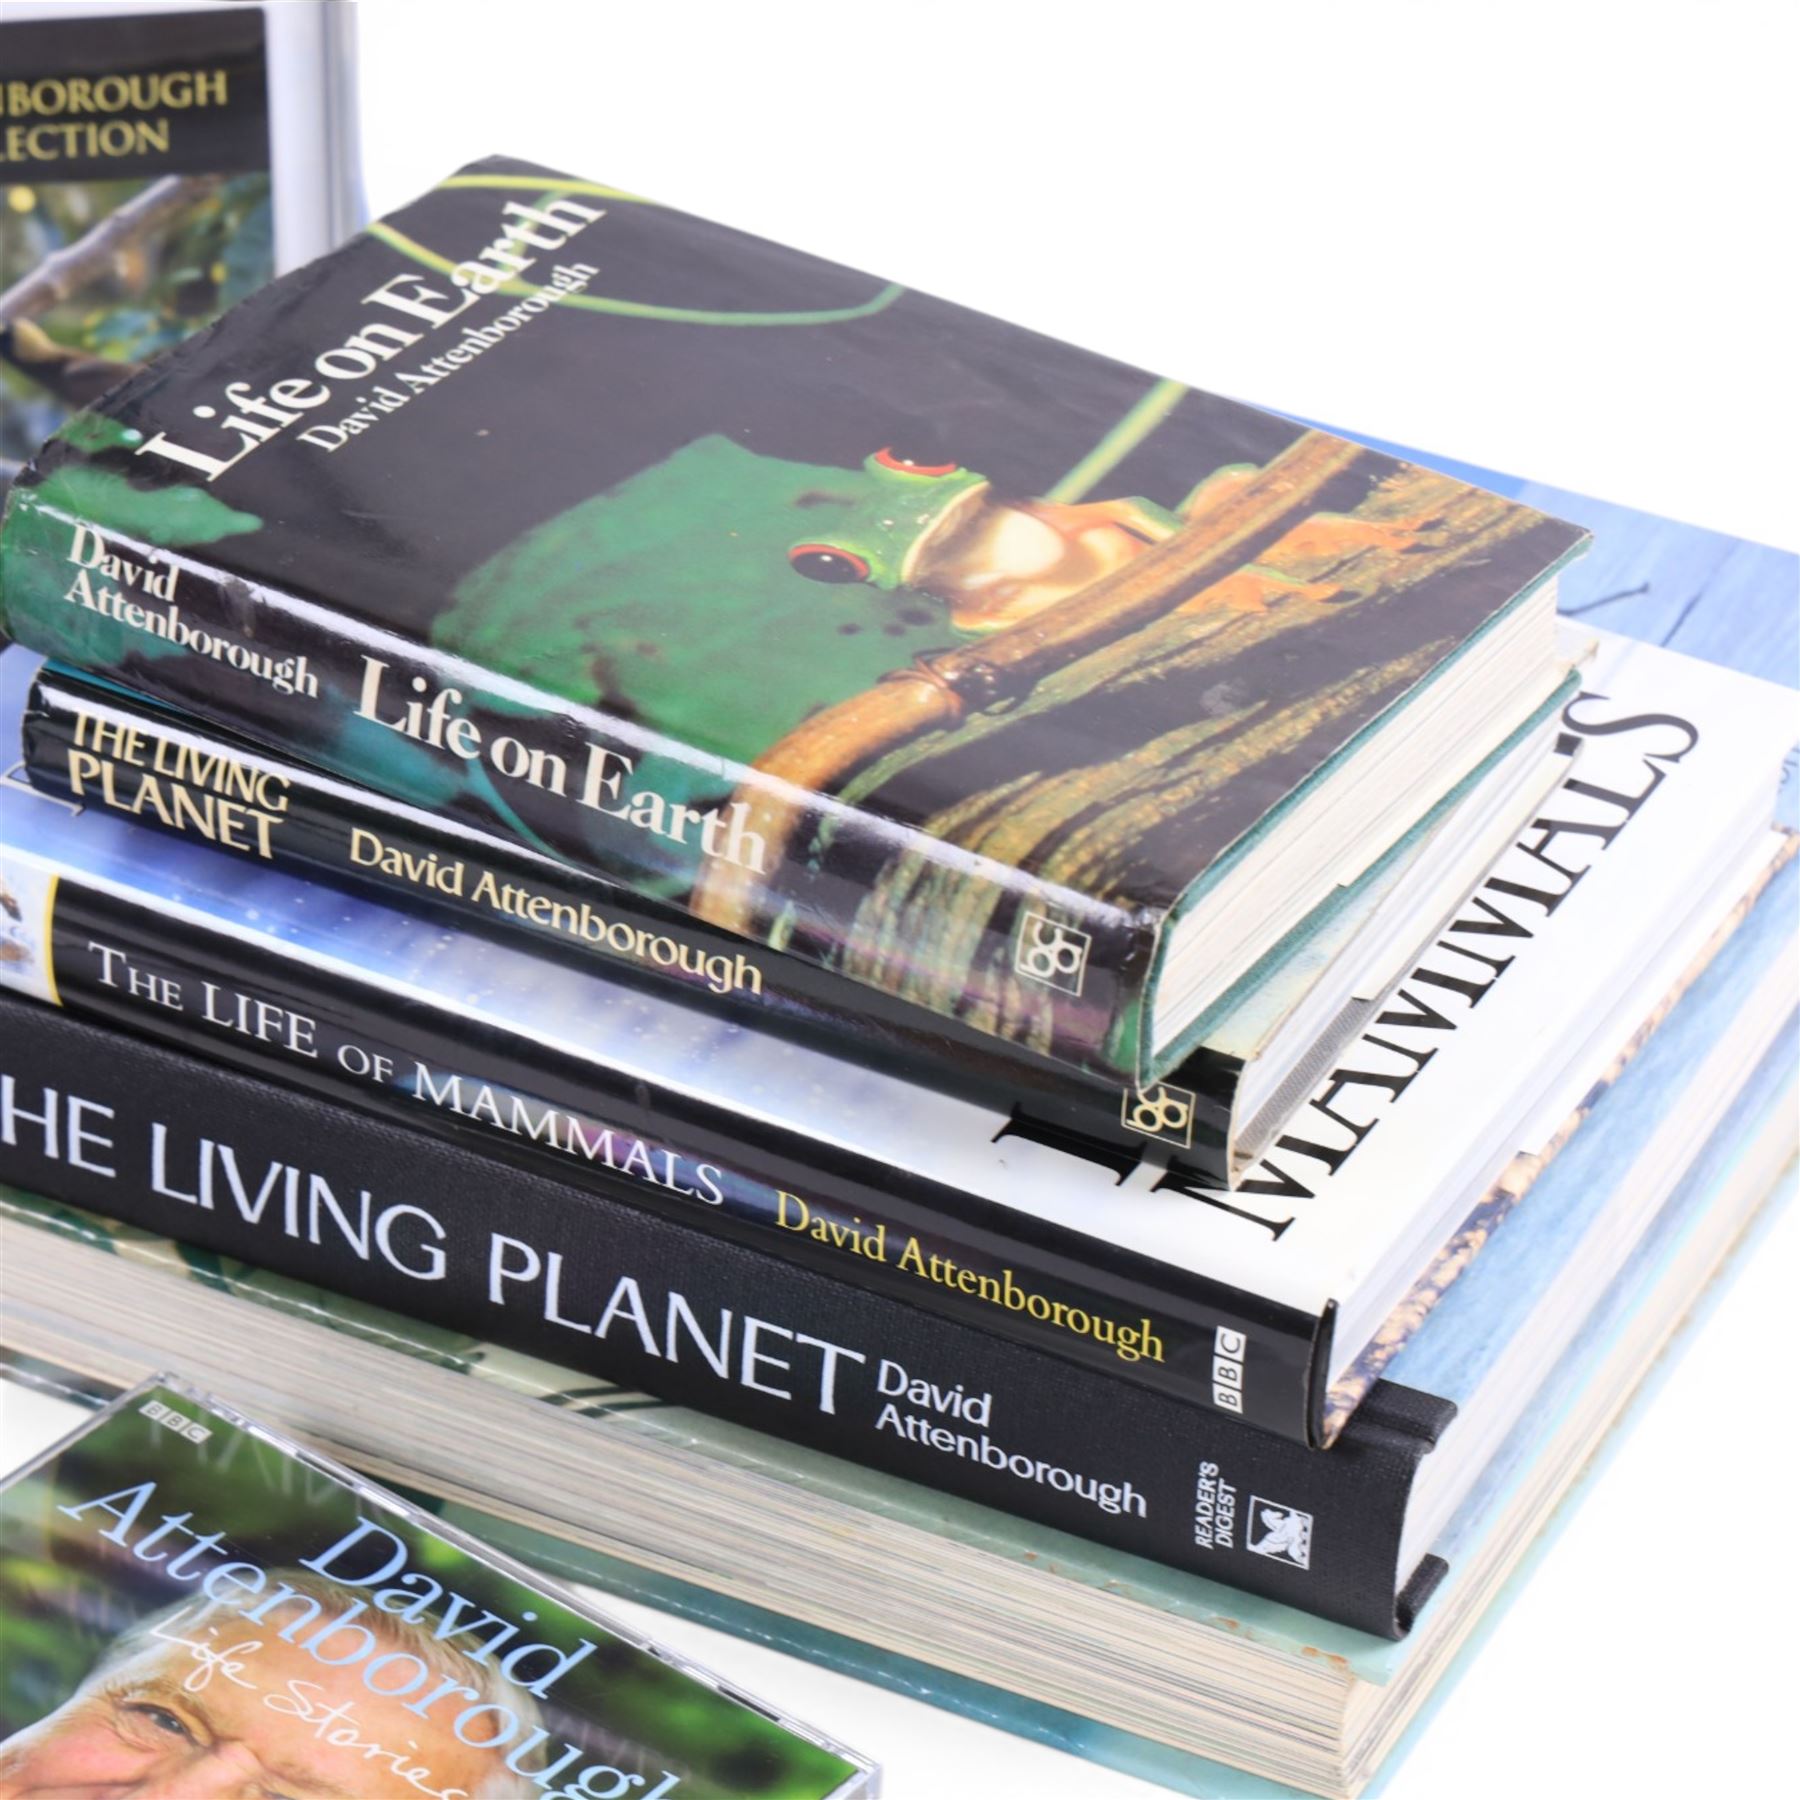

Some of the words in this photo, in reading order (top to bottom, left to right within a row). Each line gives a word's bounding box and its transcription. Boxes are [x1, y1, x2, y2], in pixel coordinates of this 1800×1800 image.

[0, 70, 228, 118] BOROUGH
[0, 118, 170, 162] ECTION
[362, 194, 607, 330] Earth
[297, 371, 410, 452] David
[406, 259, 600, 395] Attenborough
[315, 323, 423, 381] on
[136, 382, 330, 481] Life
[68, 524, 180, 601] David
[64, 570, 318, 699] Attenborough
[68, 748, 284, 859] PLANET
[73, 711, 145, 767] THE
[154, 740, 290, 812] LIVING
[353, 655, 482, 759] Life
[491, 736, 567, 795] on
[575, 743, 767, 875] Earth
[351, 827, 464, 896] David
[471, 871, 763, 994] Attenborough
[88, 941, 183, 1011] THE
[202, 982, 318, 1058] LIFE
[337, 1045, 394, 1083] OF
[412, 1061, 724, 1206] MAMMALS
[775, 1190, 887, 1263] David
[896, 1236, 1165, 1364] Attenborough
[151, 1123, 446, 1280] LIVING
[489, 1233, 866, 1414] PLANET
[876, 1359, 992, 1427] David
[1212, 1325, 1247, 1414] BBC
[138, 1400, 213, 1444] BBC
[875, 1403, 1147, 1518] Attenborough
[1195, 1461, 1219, 1549] READER'S
[1215, 1478, 1237, 1548] DIGEST
[57, 1481, 682, 1800] Attenboroug
[149, 1606, 257, 1692] Life
[299, 1515, 598, 1700] David
